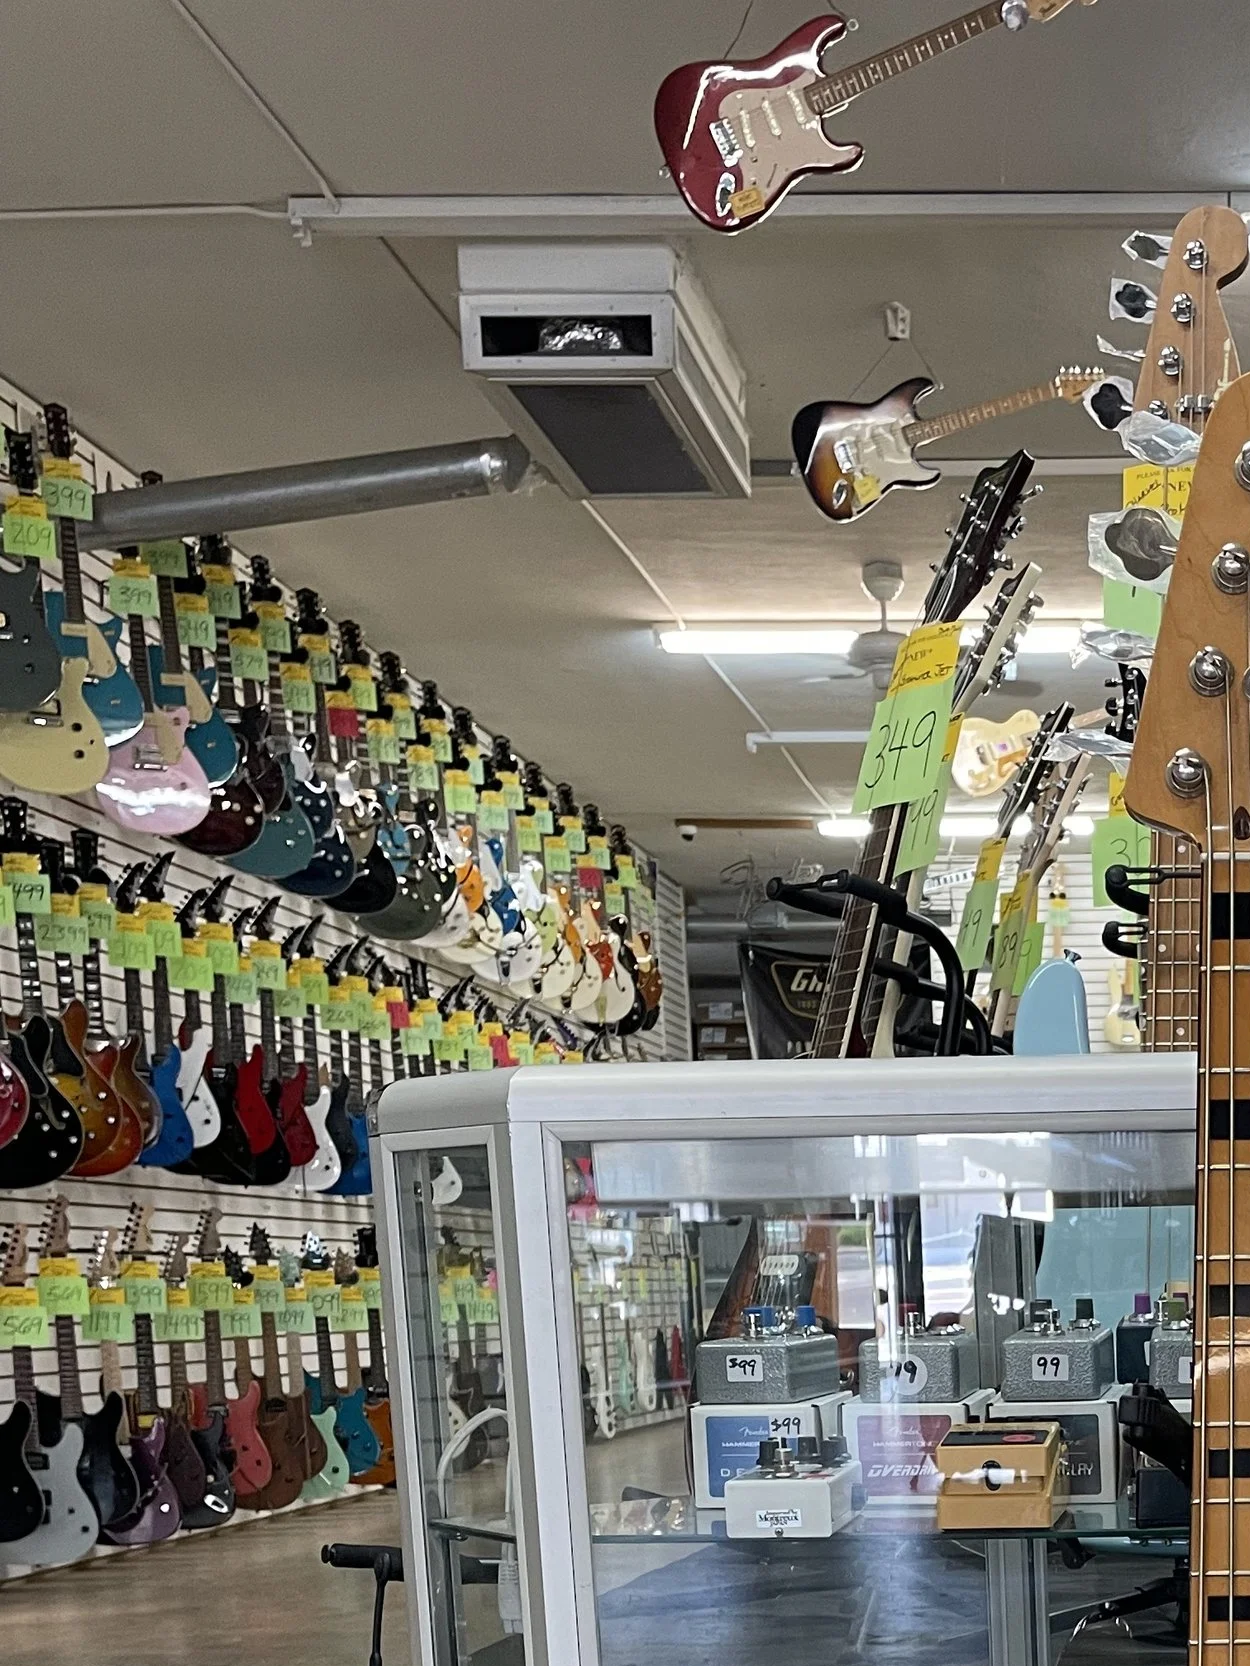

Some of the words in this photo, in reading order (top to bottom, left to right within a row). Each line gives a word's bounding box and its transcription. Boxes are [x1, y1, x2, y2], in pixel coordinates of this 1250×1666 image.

[865, 710, 937, 789] 349
[3, 1315, 43, 1335] 569
[728, 1357, 757, 1376] $99
[1036, 1355, 1062, 1377] 99
[771, 1416, 801, 1435] $99
